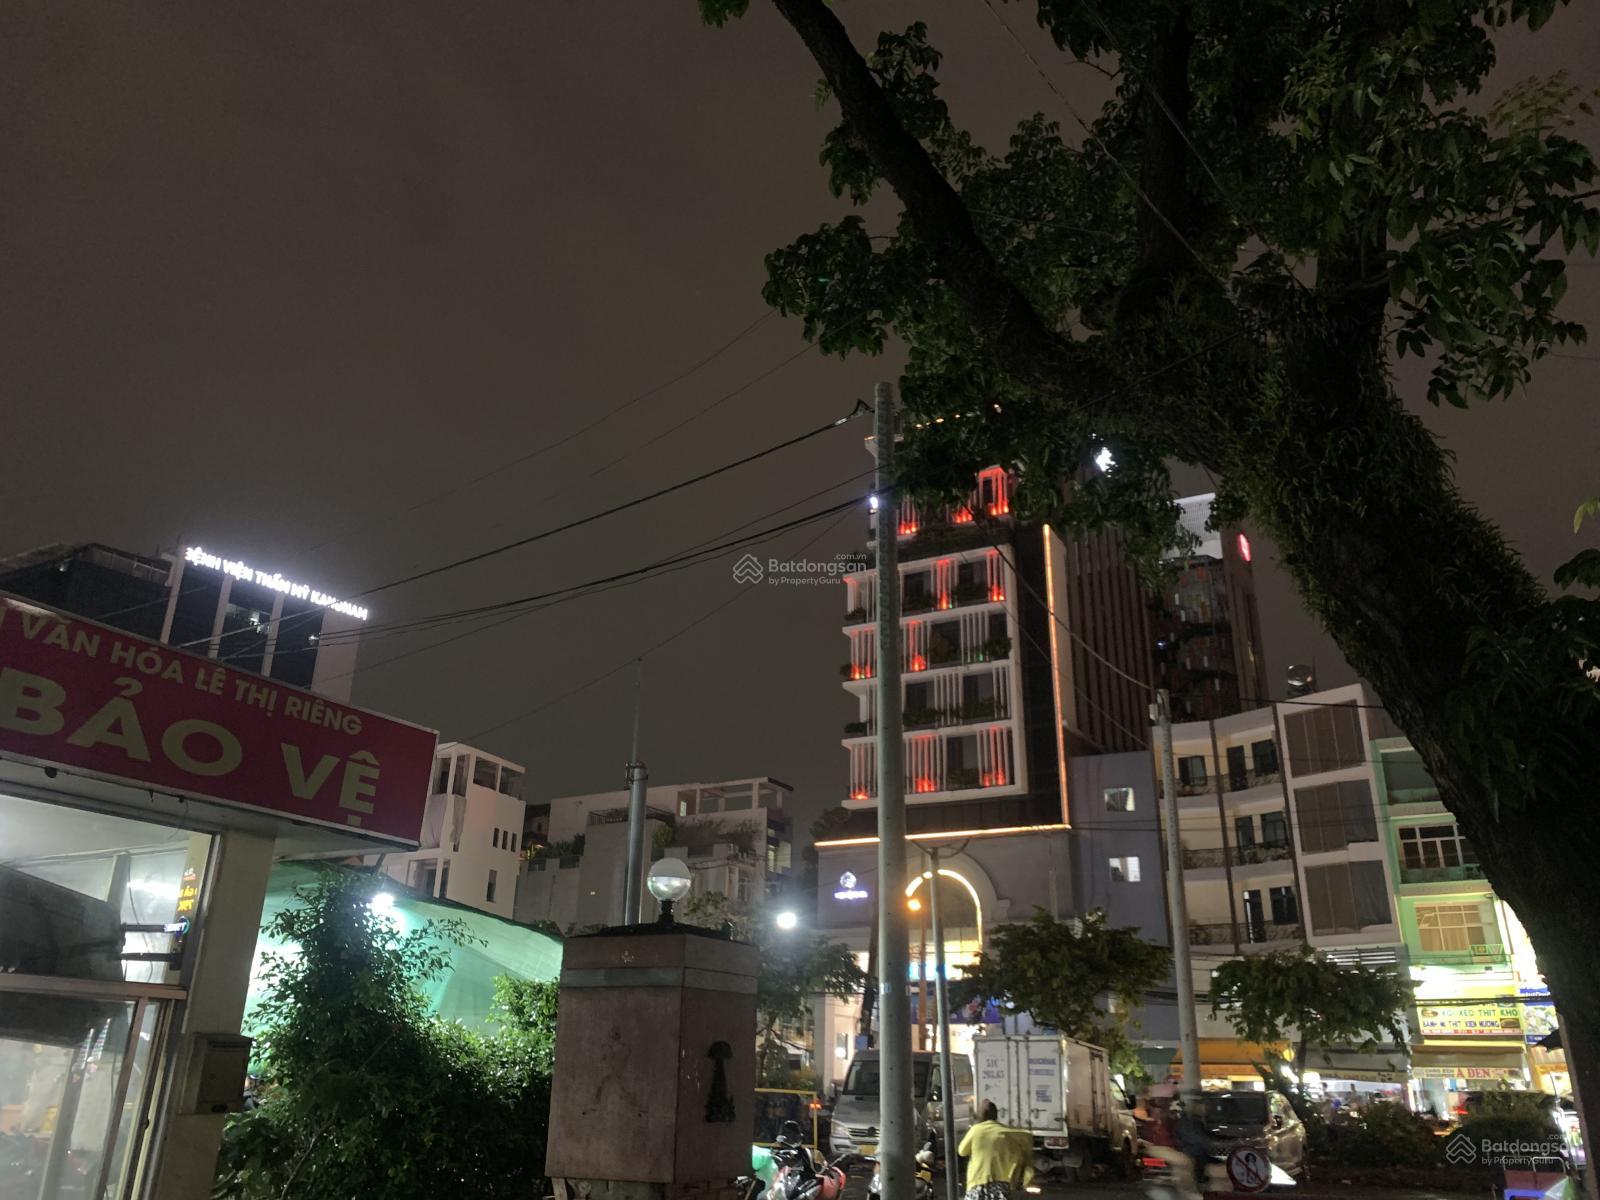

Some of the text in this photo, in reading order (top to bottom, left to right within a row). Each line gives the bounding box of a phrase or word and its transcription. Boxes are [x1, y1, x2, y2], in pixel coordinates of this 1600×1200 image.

[21, 610, 101, 658] VĂN
[111, 638, 185, 686] HÓA
[195, 667, 226, 696] LÊ
[235, 678, 277, 718] THỊ
[283, 695, 363, 736] RIÊNG
[0, 667, 381, 828] BẢO VỆ
